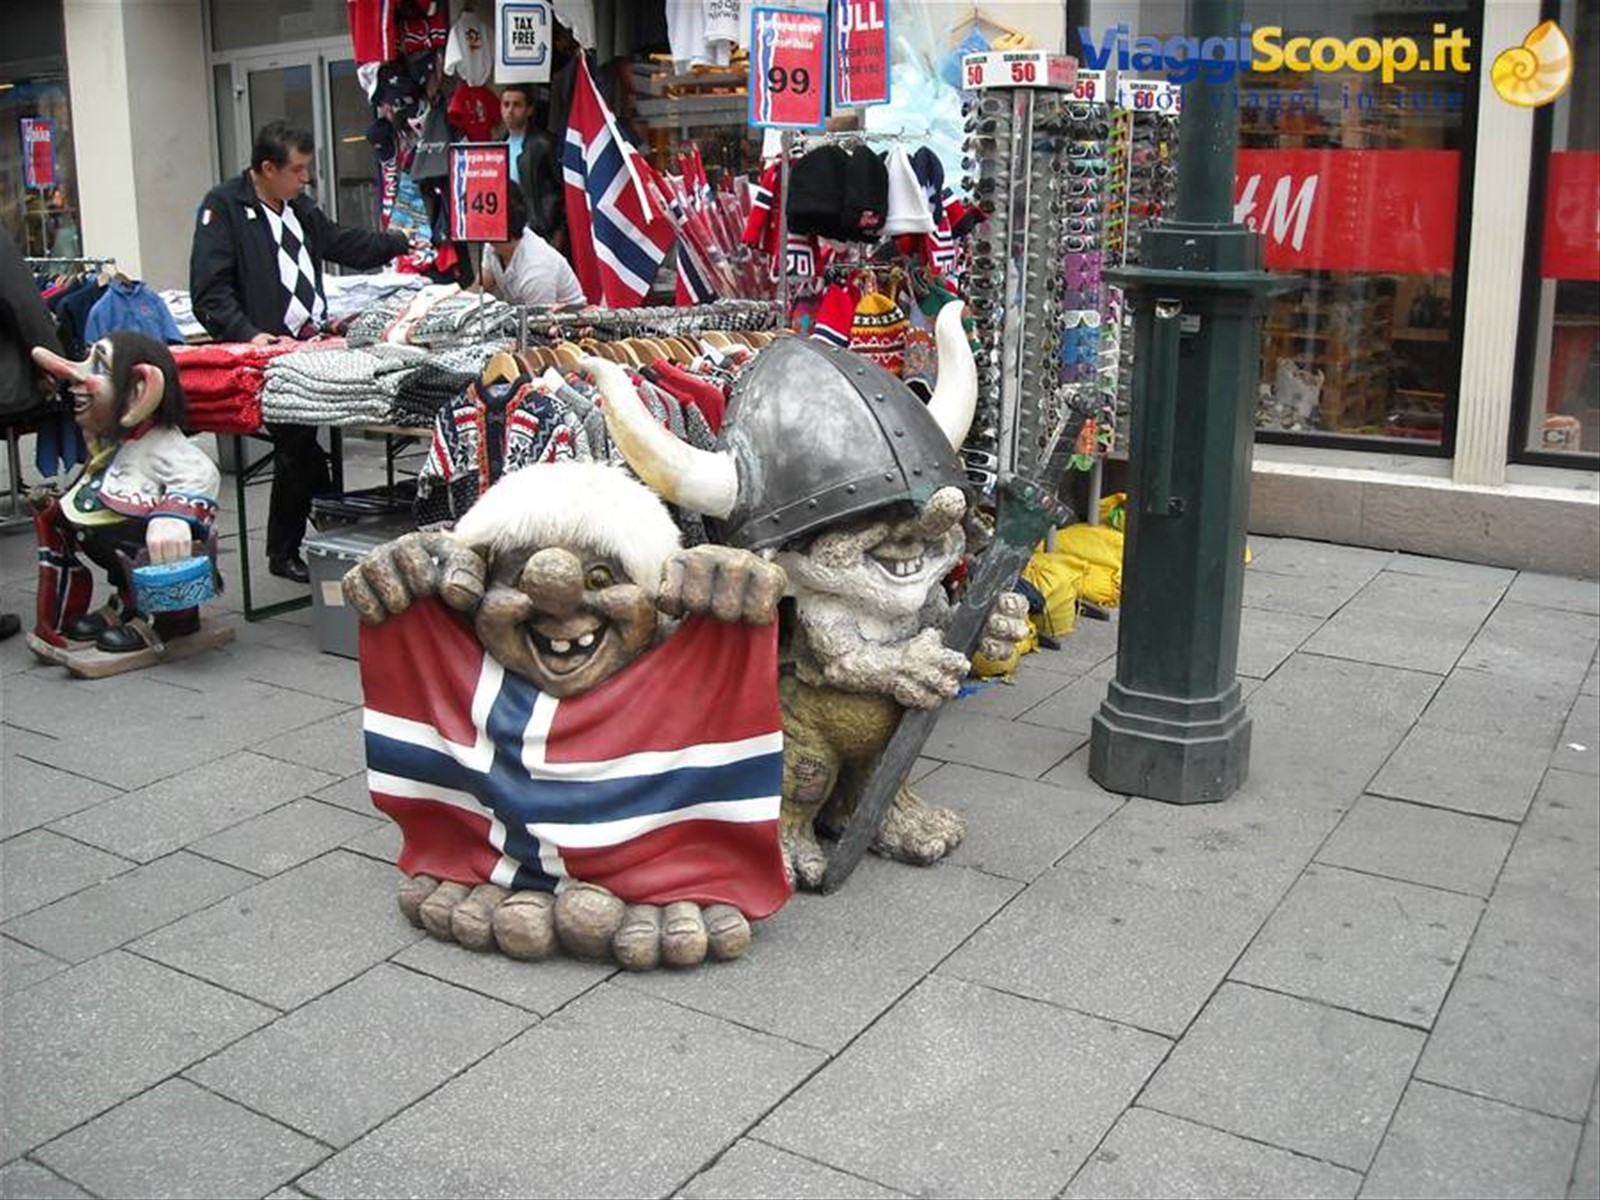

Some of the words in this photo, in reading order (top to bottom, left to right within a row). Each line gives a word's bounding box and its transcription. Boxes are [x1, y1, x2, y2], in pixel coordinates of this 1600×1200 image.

[514, 17, 533, 30] TAX
[512, 31, 535, 45] FREE
[967, 66, 984, 86] 50
[1011, 63, 1036, 83] 50
